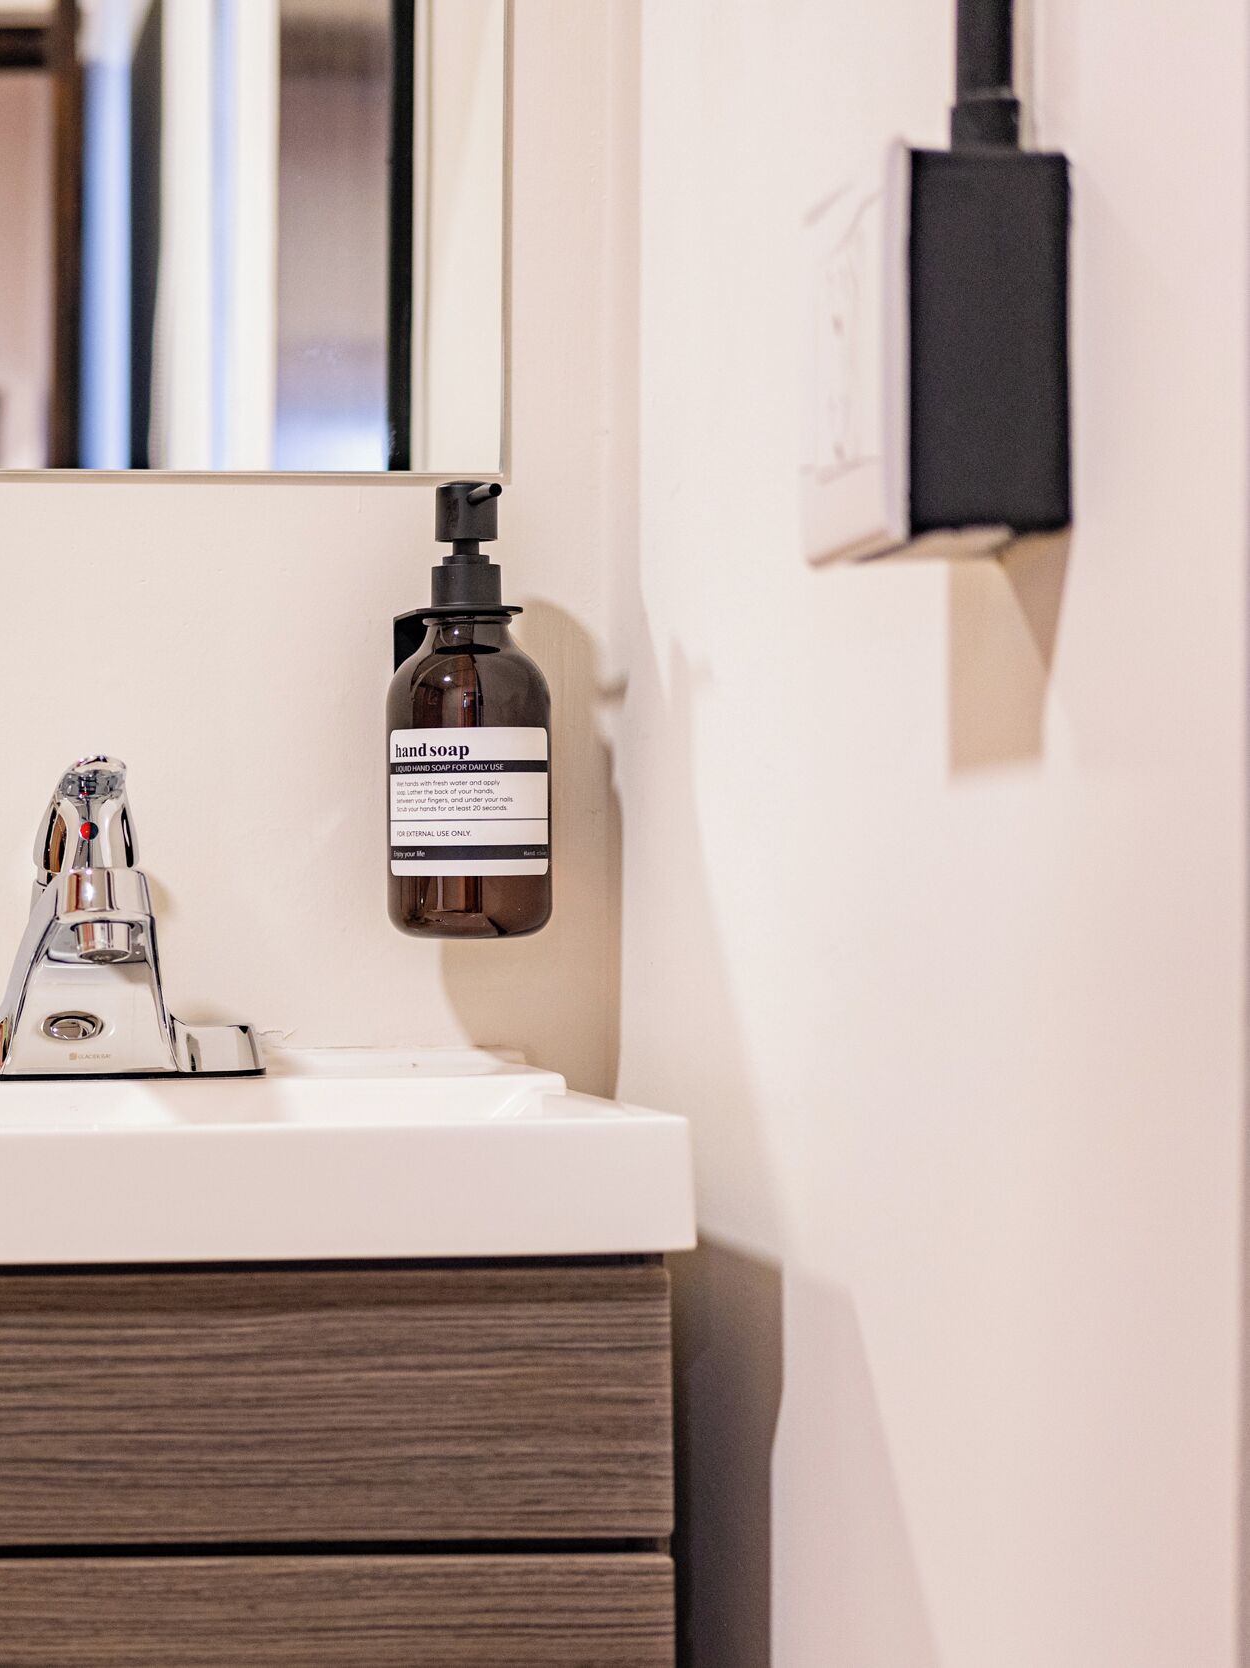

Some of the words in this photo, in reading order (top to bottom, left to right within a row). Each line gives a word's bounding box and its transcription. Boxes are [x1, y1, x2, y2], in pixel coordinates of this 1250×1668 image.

[395, 743, 427, 758] hand
[429, 745, 470, 760] soap
[395, 765, 411, 773] LIQUID
[412, 764, 430, 772] HAND
[468, 763, 488, 771] DAILY
[489, 763, 504, 771] USE
